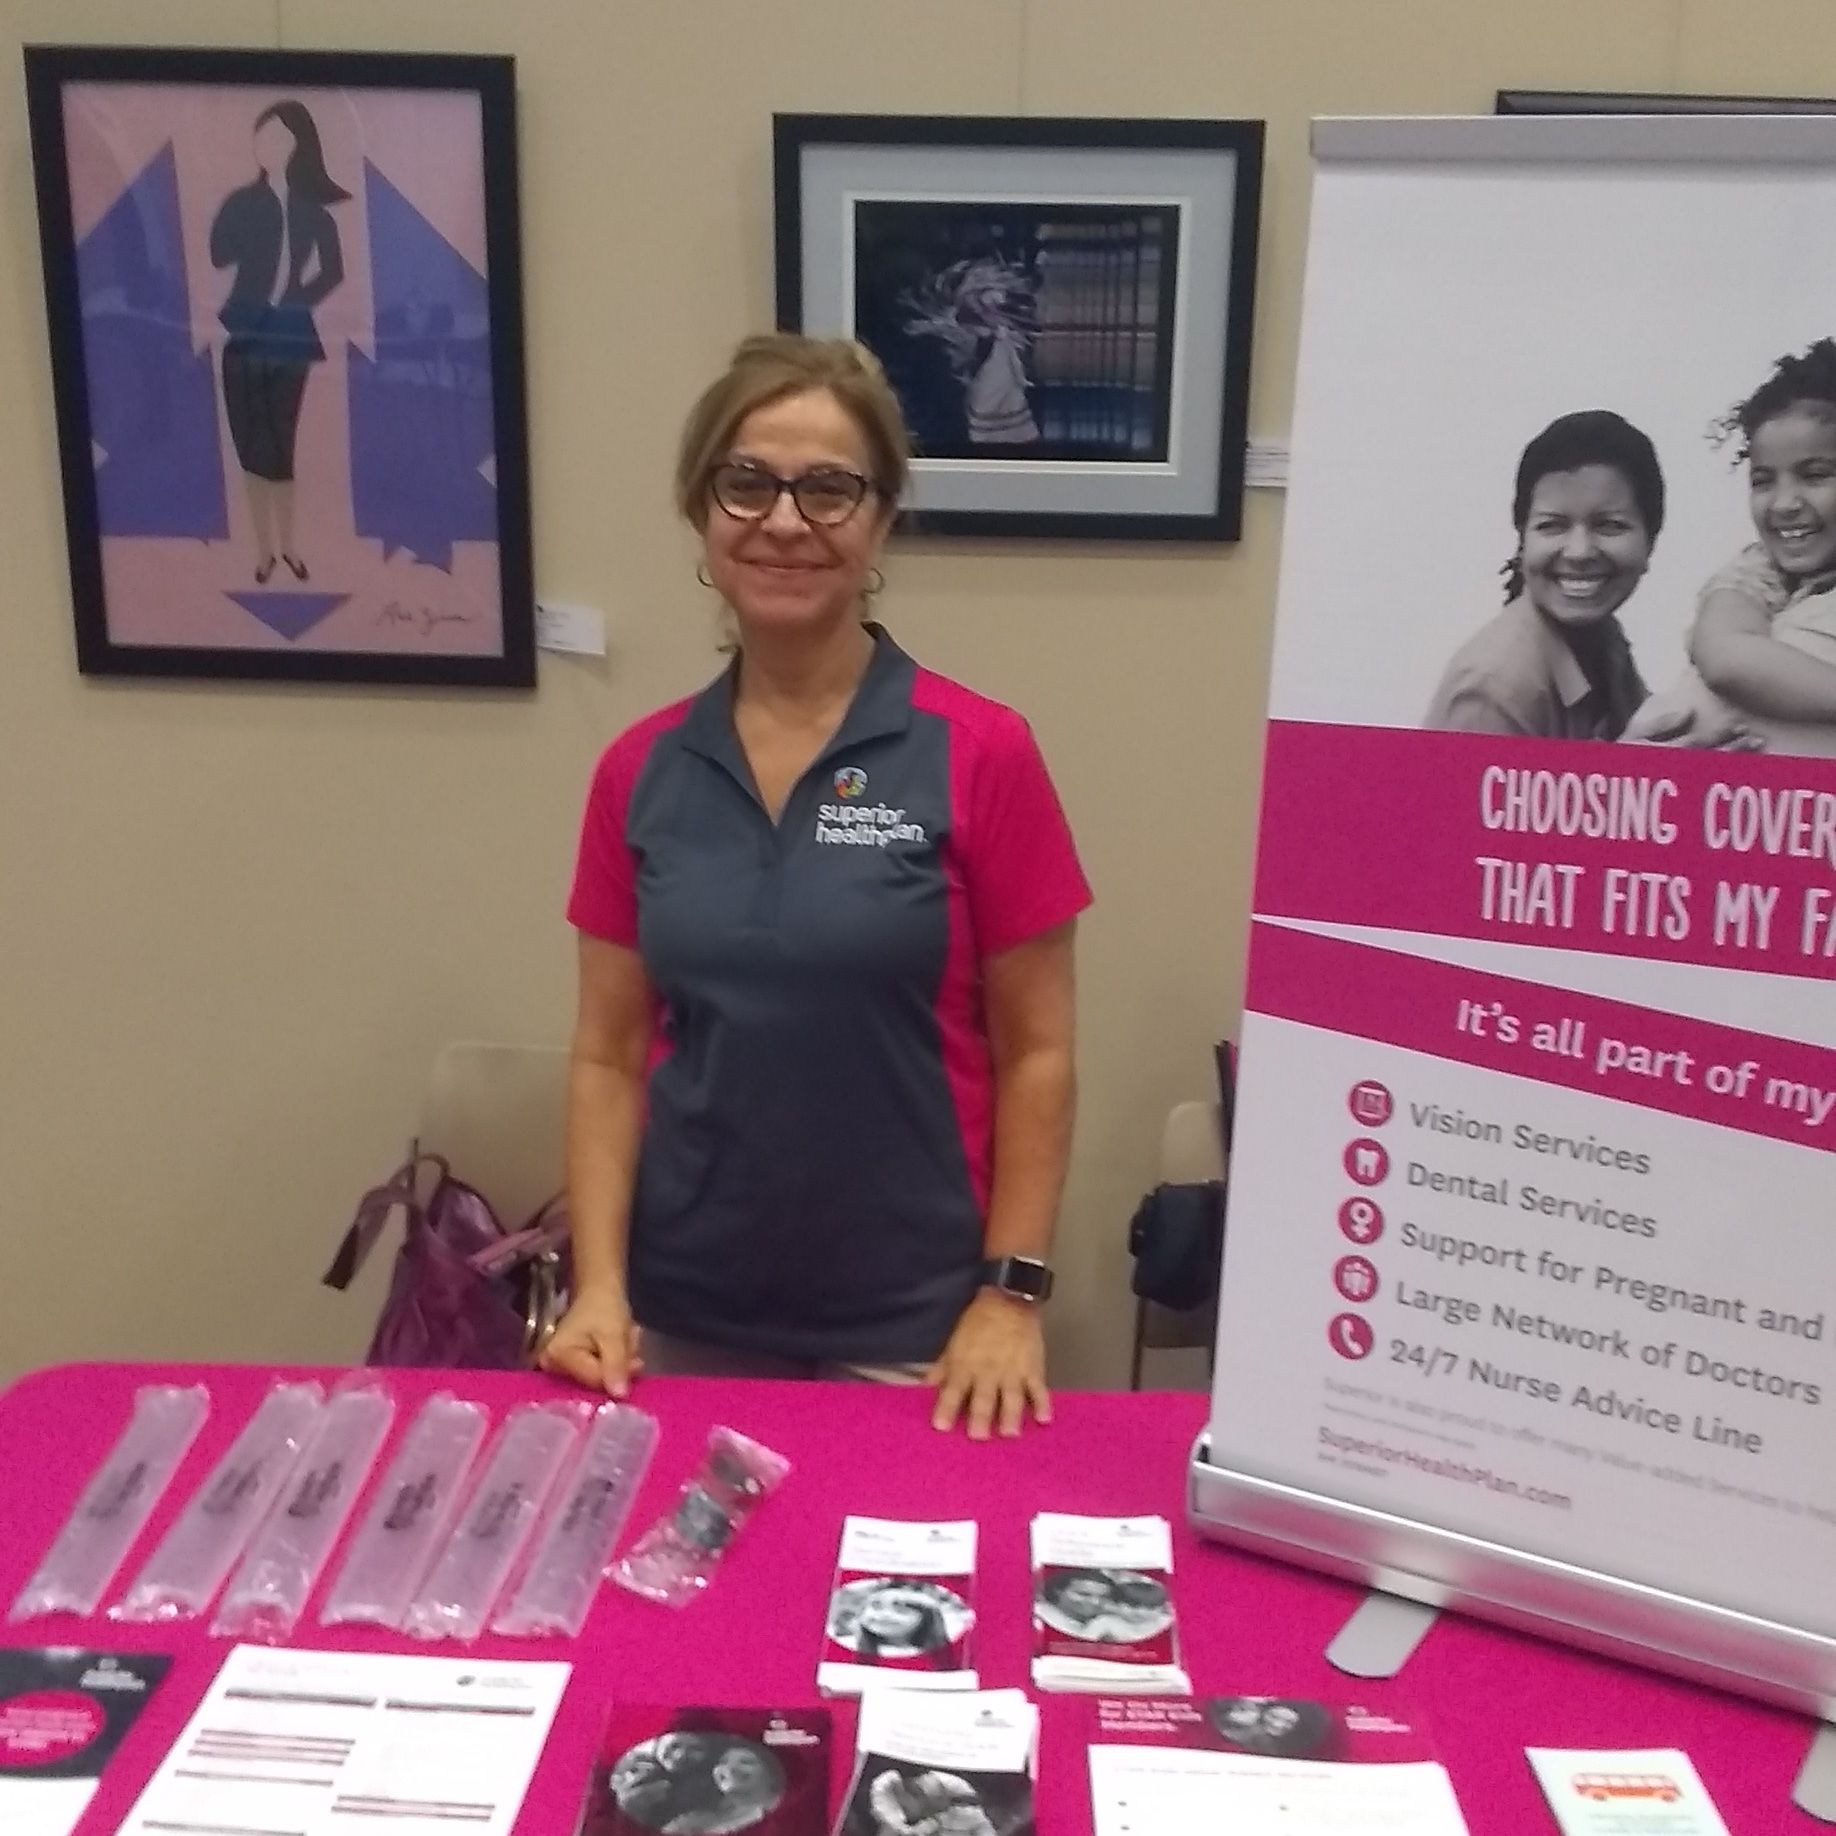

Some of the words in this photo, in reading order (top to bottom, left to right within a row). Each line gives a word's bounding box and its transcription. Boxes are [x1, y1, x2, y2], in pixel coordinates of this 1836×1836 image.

[818, 802, 906, 826] superior
[1480, 765, 1679, 845] CHOOSING
[1475, 857, 1586, 929] THAT
[1602, 869, 1692, 941] FITS
[1713, 880, 1781, 950] MY
[1532, 1017, 1585, 1059] all
[1597, 1038, 1695, 1086] part
[1706, 1061, 1761, 1098] of
[1764, 1078, 1836, 1127] my
[1410, 1102, 1503, 1145] Vision
[1513, 1124, 1652, 1175] Services
[1407, 1161, 1510, 1206] Dental
[1519, 1186, 1659, 1239] Services
[1401, 1222, 1527, 1272] Support
[1538, 1251, 1584, 1286] for
[1594, 1266, 1746, 1325] Pregnant
[1757, 1308, 1824, 1341] and
[1395, 1281, 1482, 1326] Large
[1491, 1304, 1629, 1360] Network
[1640, 1343, 1676, 1369] of
[1685, 1350, 1823, 1405] Doctors
[1389, 1337, 1459, 1378] 24/7
[1467, 1358, 1562, 1403] Nurse
[1571, 1384, 1682, 1434] Advice
[1691, 1415, 1763, 1454] Line
